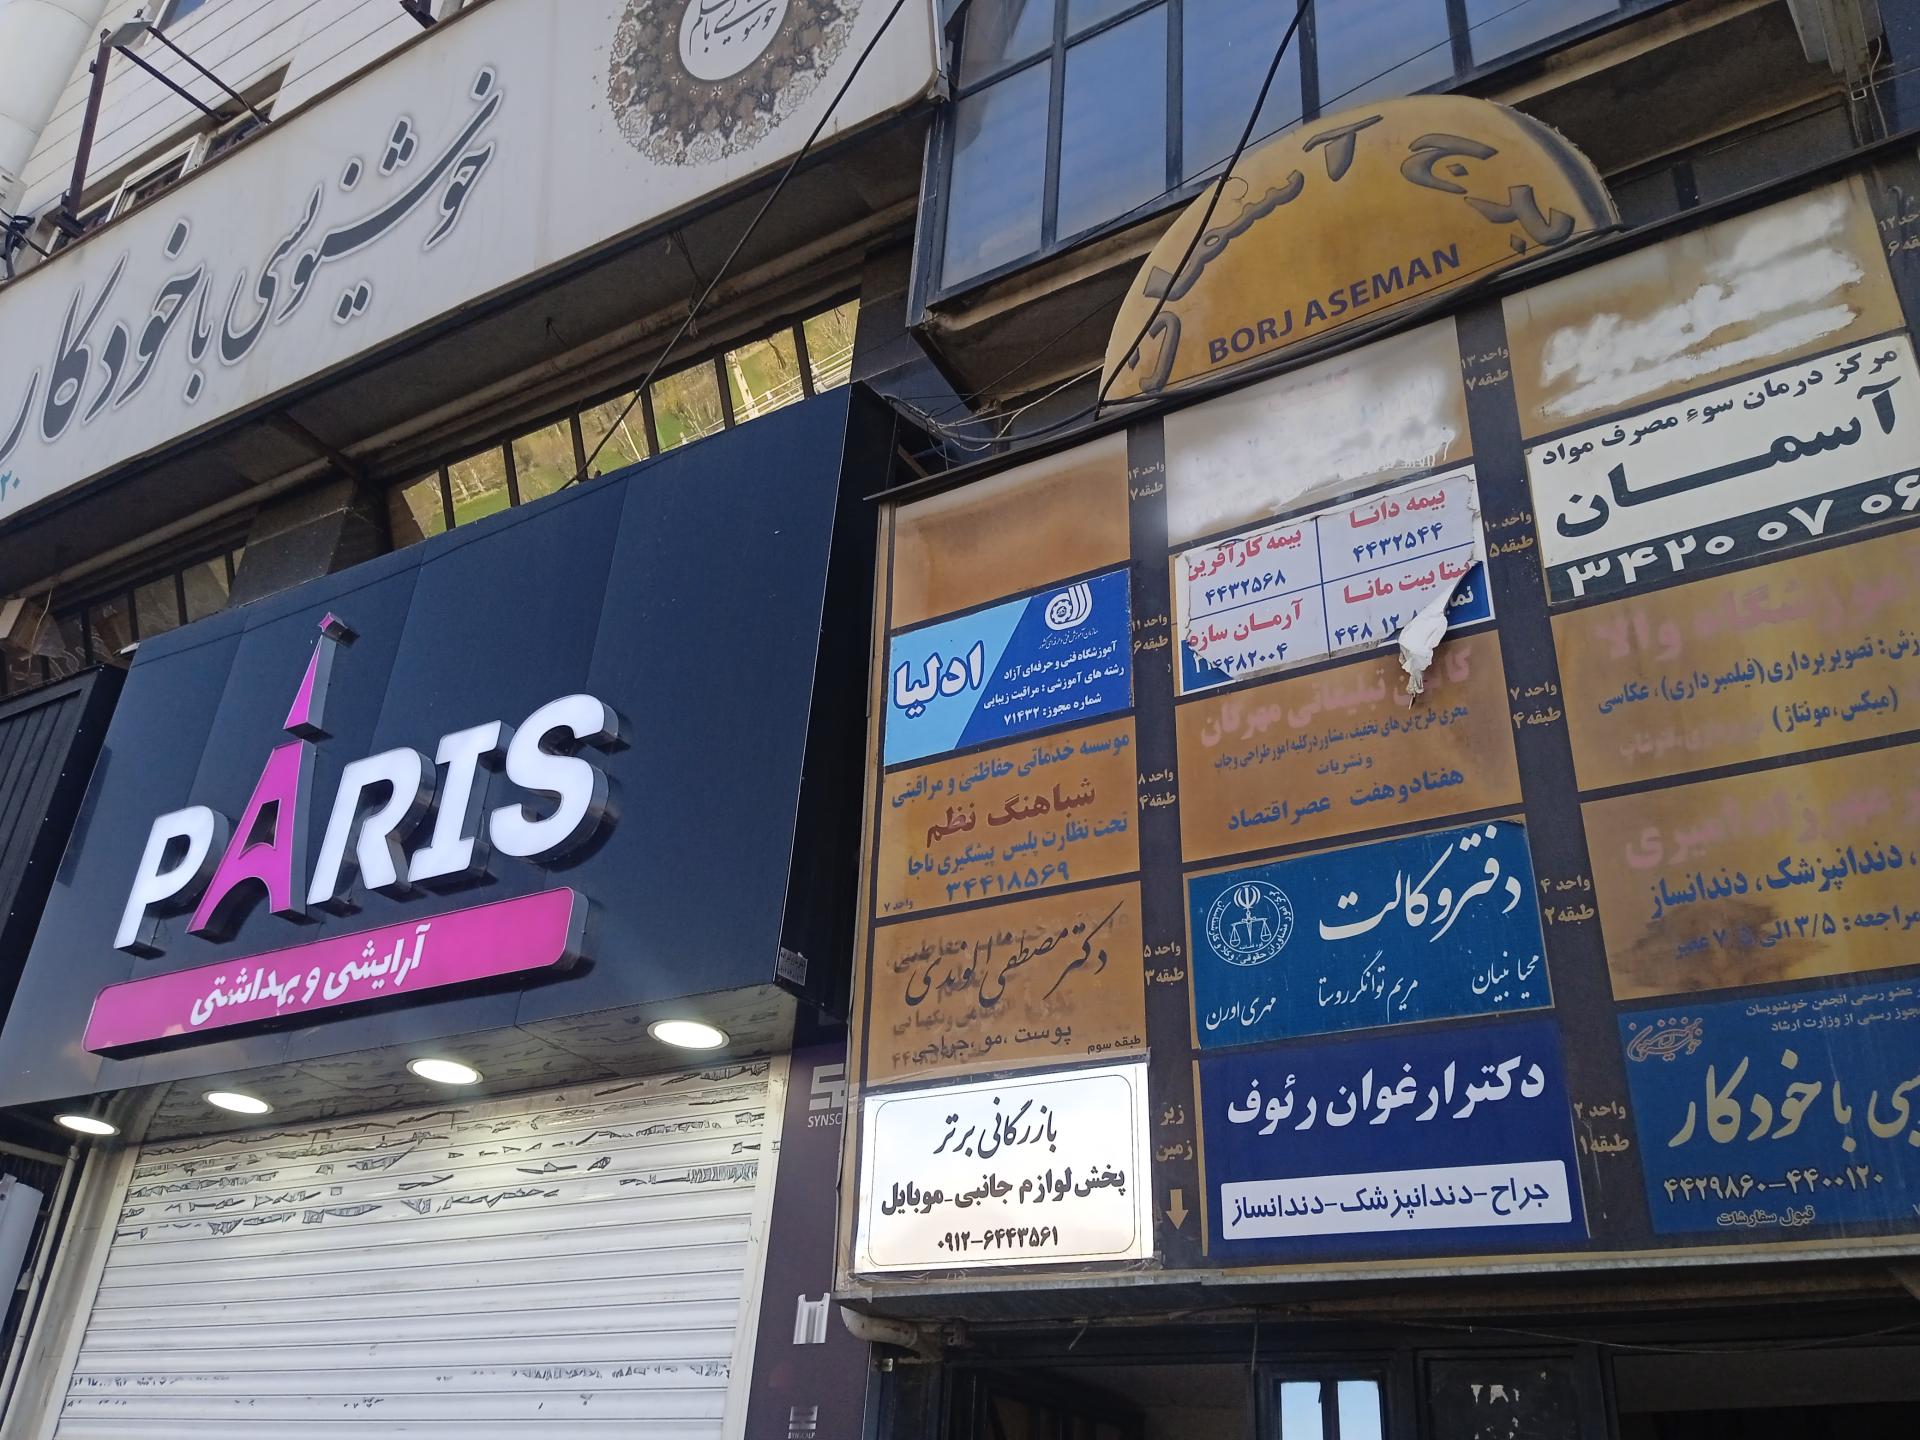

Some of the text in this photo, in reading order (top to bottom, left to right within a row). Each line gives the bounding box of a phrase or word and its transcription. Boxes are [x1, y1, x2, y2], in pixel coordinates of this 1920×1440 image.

[0, 66, 503, 461] خوشنویسی با خودکار
[1126, 114, 1576, 393] برج آسمان
[1209, 243, 1461, 364] BORJ ASEMAN
[1480, 346, 1509, 362] واحد
[1834, 350, 1898, 385] مرکز
[1465, 369, 1509, 391] طبقه ۷
[1743, 370, 1824, 409] درمان
[1601, 413, 1680, 447] مصرف
[1542, 439, 1594, 465] مواد
[1556, 376, 1902, 539] آسمان
[1142, 461, 1165, 475] واحد
[1129, 482, 1164, 501] طبقه ۷
[1349, 488, 1446, 530] بیمه دانا
[1502, 511, 1532, 527] واحد
[1267, 529, 1302, 552] بیمه
[1352, 521, 1444, 564] ۴۴۳۲۵۴۴
[1490, 535, 1534, 558] طبقه ۵
[1205, 568, 1287, 607] ۴۴۳۲۵۶۸
[1344, 570, 1435, 604] بیت مانا
[1144, 614, 1168, 628] واحد
[1189, 598, 1303, 652] آرمان سازه
[1133, 635, 1169, 655] طبقه ۶
[1004, 640, 1117, 680] آموزشگاه فنی و آزاد
[1104, 665, 1124, 678] رشته
[896, 642, 984, 718] ادلیا
[1084, 668, 1101, 685] های
[1510, 680, 1558, 699] واحد ۷
[983, 692, 1010, 710] زیبایی
[1011, 685, 1040, 701] مراقبت
[1599, 684, 1650, 714] عکاسی
[1004, 693, 1102, 726] شماره مجوز: ۷۱۴۳۲
[1415, 708, 1437, 731] طرح
[1439, 706, 1468, 726] مجری
[1512, 706, 1562, 729] طبقه ۴
[1381, 716, 1400, 737] های
[892, 733, 1129, 809] موسسه خدماتی حفاظتی و مراقبتی
[1138, 769, 1174, 786] واحد ۸
[1316, 753, 1373, 776] و نشریات
[113, 612, 612, 950] PARIS
[926, 776, 1096, 848] شباهنگ نظم
[1150, 791, 1177, 809] طبقه
[1227, 766, 1464, 831] هفتاد و هفت عصر اقتصاد
[908, 812, 1128, 881] تحت نظارت پلیس پیشگیری ناجا
[946, 861, 1070, 902] ۳۴۴۱۸۵۶۹
[1318, 842, 1453, 942] وکالت
[1429, 824, 1522, 944] دفتر
[1554, 875, 1591, 895] واحد
[1651, 868, 1748, 918] دندانساز
[1558, 903, 1596, 925] طبقه
[1043, 900, 1124, 1000] دکتر
[1144, 941, 1182, 957] واحد ۵
[190, 924, 431, 1026] آرایشی و بهداشتی
[905, 936, 993, 1007] الوندی
[979, 928, 1068, 1008] مصطفی
[1144, 967, 1185, 987] طبقه ۳
[1240, 996, 1277, 1027] مهری
[1387, 976, 1418, 1023] مریم
[1746, 998, 1809, 1016] خوشنویسان
[1811, 994, 1847, 1011] انجمن
[1851, 993, 1885, 1006] رسمی
[1015, 1025, 1071, 1046] پوست
[1771, 1011, 1892, 1032] رسمی از وزارت ارشاد
[1087, 1034, 1142, 1055] طبقه سوم
[1226, 1055, 1545, 1136] دکتر ارغوان رئوف
[1668, 1049, 1822, 1148] خودکار
[1160, 1103, 1184, 1126] زیر
[1589, 1100, 1627, 1120] واحد
[1832, 1080, 1857, 1153] با
[933, 1096, 1057, 1159] بازرگانی برتر
[1156, 1143, 1193, 1162] زمین
[1591, 1131, 1630, 1157] طبقه
[1019, 1167, 1073, 1204] لوازم
[1075, 1164, 1126, 1195] پخش
[1716, 1205, 1816, 1228] قبول سفارشات
